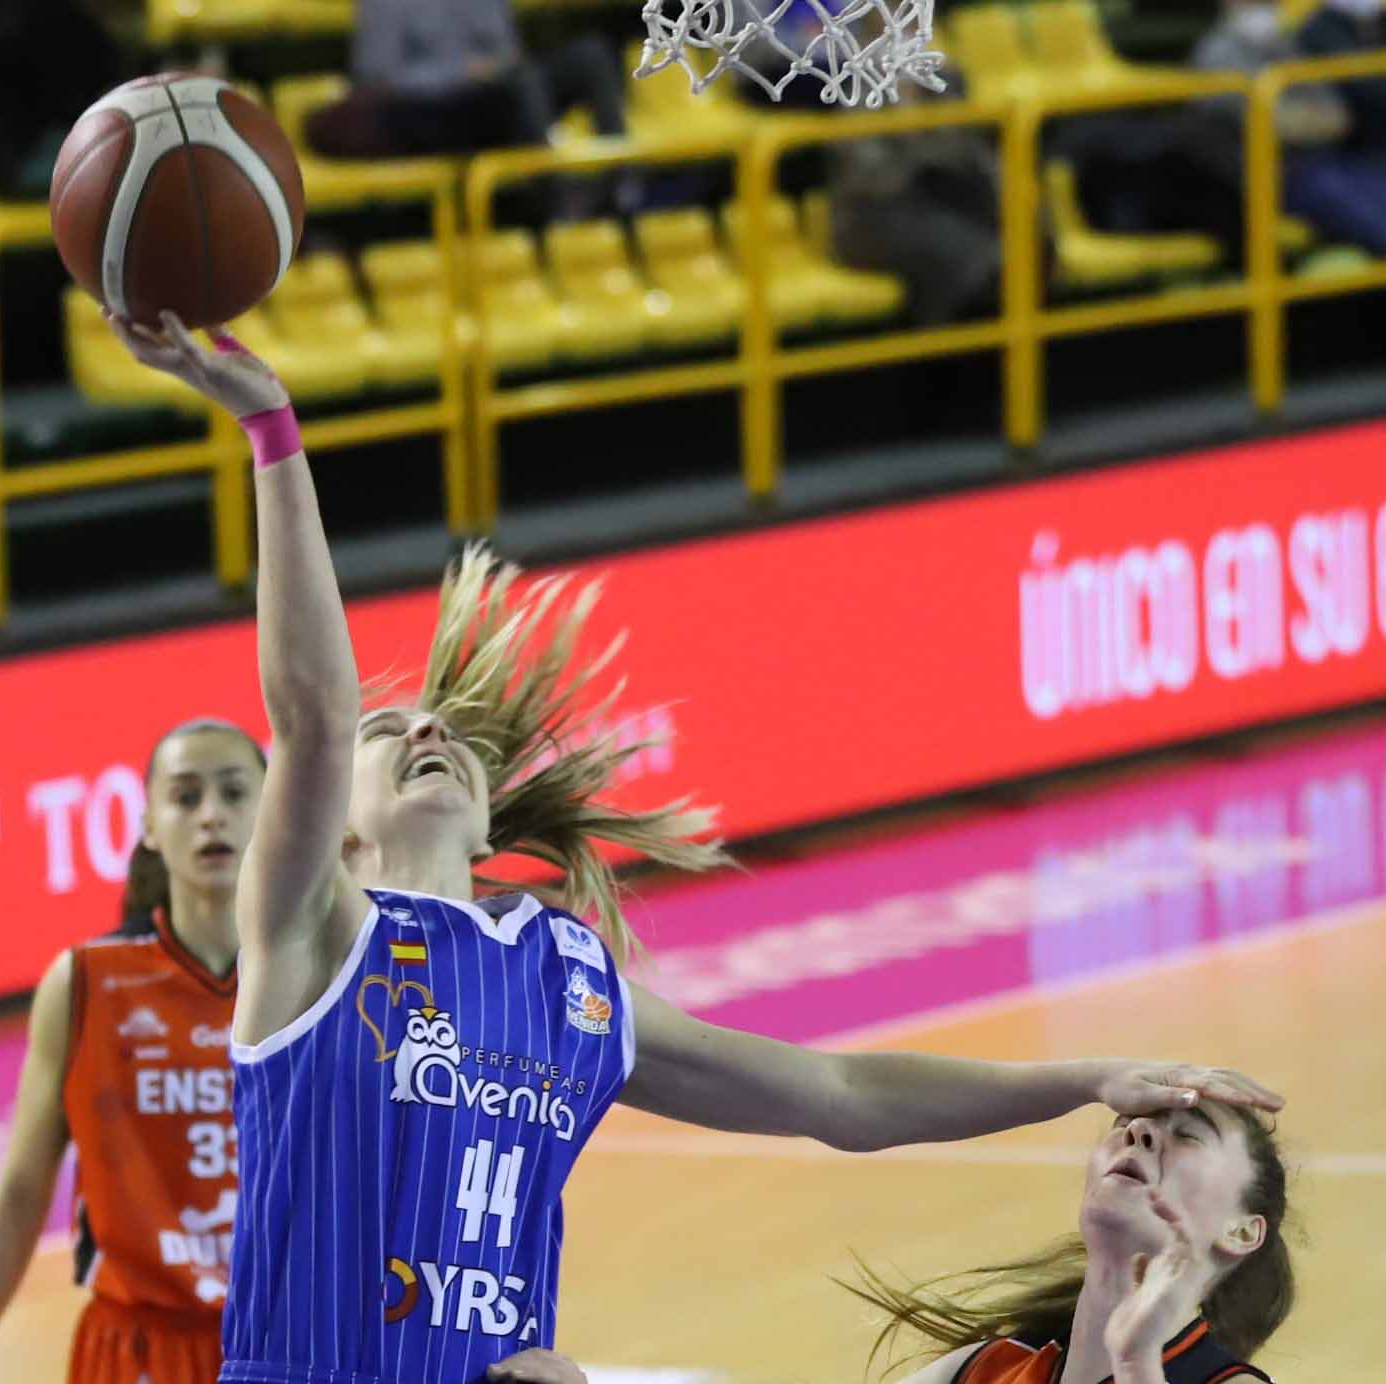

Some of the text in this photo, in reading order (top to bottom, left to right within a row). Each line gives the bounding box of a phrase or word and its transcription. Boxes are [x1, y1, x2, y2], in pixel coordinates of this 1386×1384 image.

[1020, 530, 1197, 718] ÚNICO
[1203, 522, 1284, 678] EN
[1289, 511, 1369, 662] SU
[135, 1067, 234, 1115] ENS
[456, 1139, 525, 1248] 44
